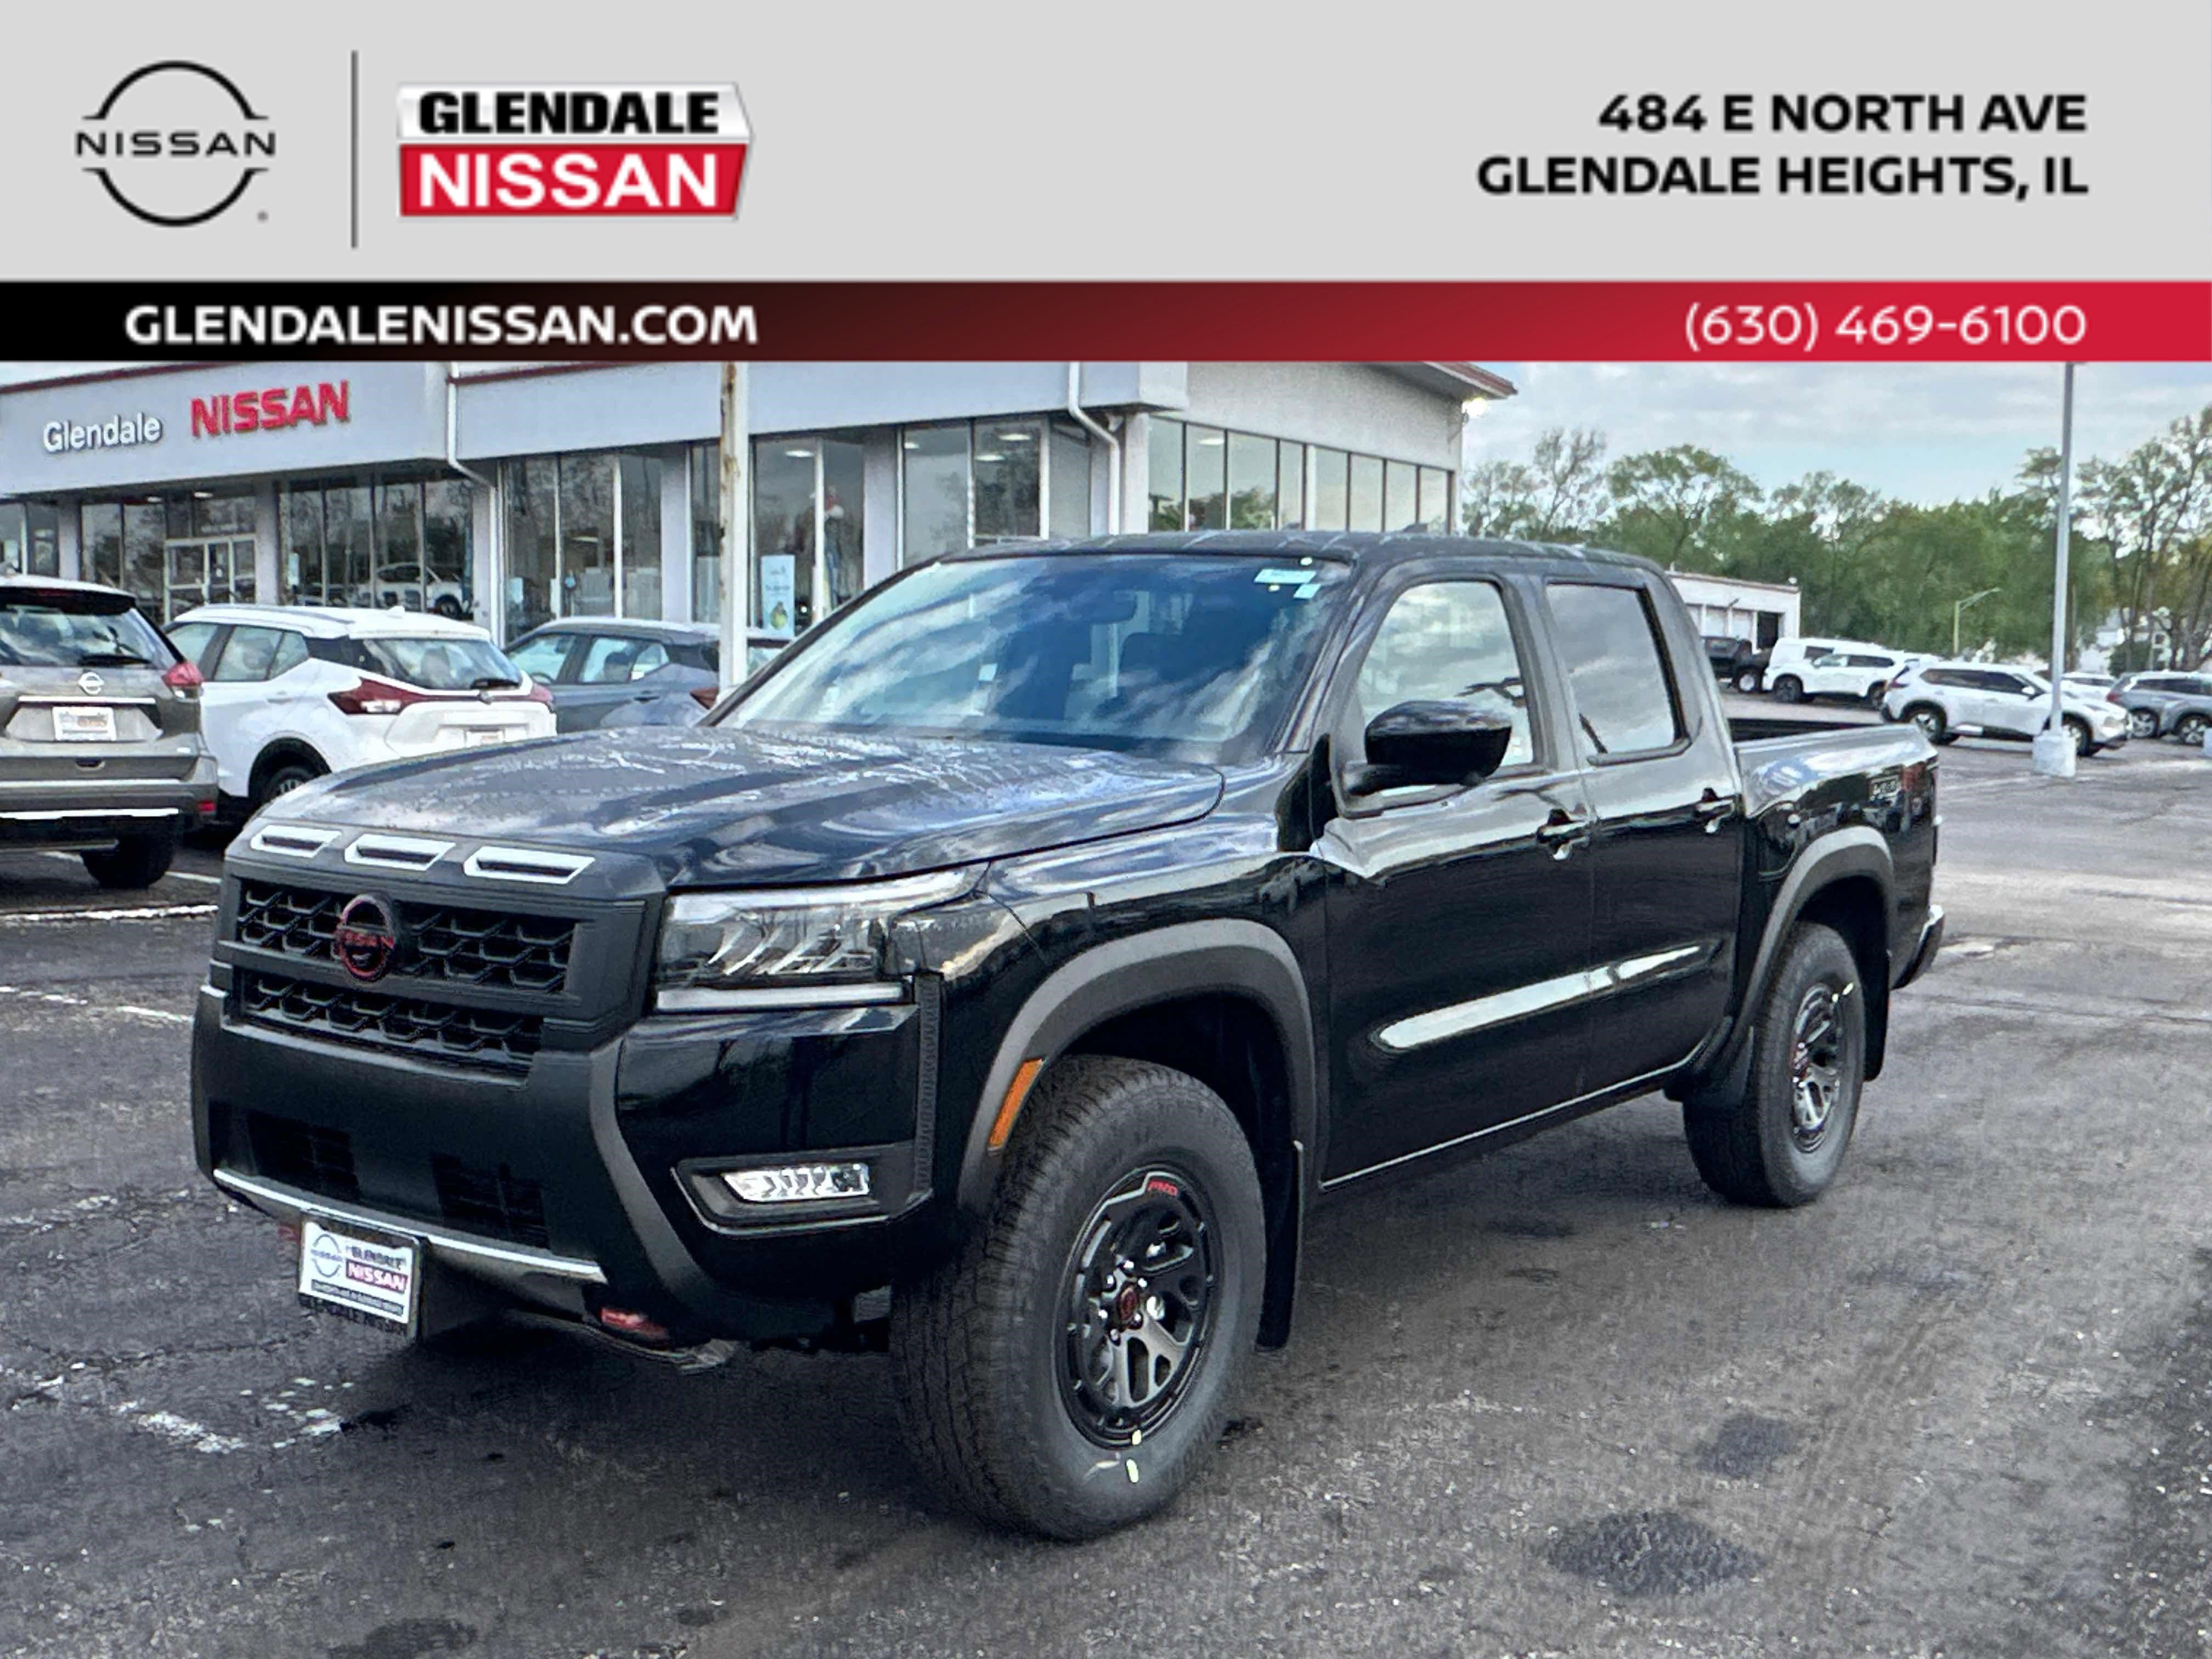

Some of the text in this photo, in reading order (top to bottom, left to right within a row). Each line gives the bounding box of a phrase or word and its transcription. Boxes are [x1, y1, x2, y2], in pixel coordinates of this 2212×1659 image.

[43, 380, 349, 453] Glendale NISSAN
[348, 1262, 407, 1291] NISSAN
